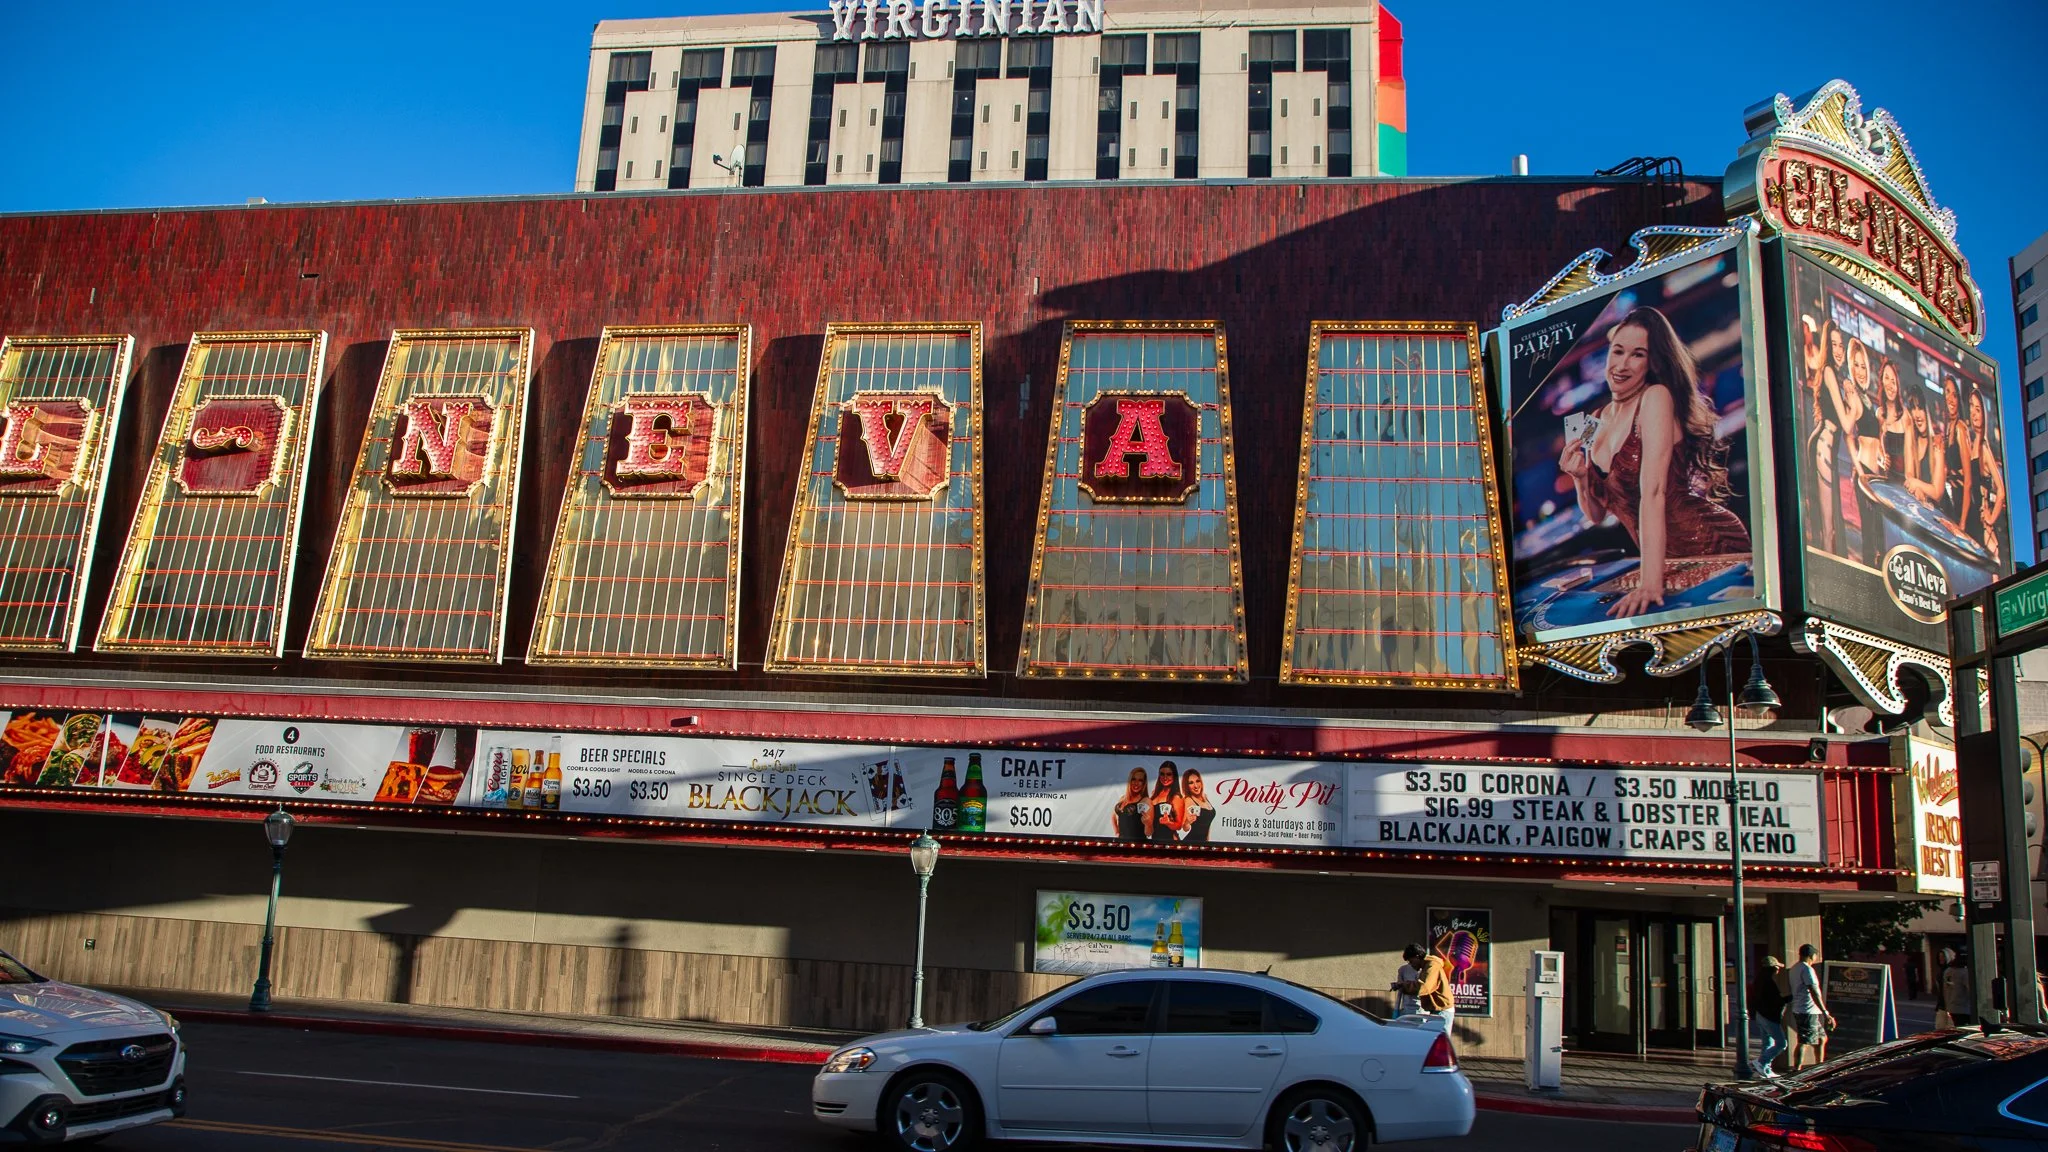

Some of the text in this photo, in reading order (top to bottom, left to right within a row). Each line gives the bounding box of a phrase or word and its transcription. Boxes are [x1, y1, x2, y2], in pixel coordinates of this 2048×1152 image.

[829, 0, 1105, 41] VIRGINIAN
[1513, 323, 1577, 360] PARTY
[1892, 554, 1915, 585] Cal
[1916, 562, 1947, 595] Neva
[1918, 595, 1931, 610] Best
[1931, 600, 1942, 613] Bet
[2011, 602, 2018, 615] N
[287, 730, 295, 741] 4
[255, 745, 326, 758] FOOD RESTAURANTS
[580, 747, 666, 766] BEER SPECIALS
[762, 748, 785, 760] 24/7
[288, 773, 317, 781] SPORTS
[500, 759, 508, 785] LIGHT
[717, 771, 827, 786] SINGLE DECK
[1000, 757, 1067, 779] CRAFT
[572, 777, 611, 798] $3.50
[629, 780, 669, 802] $3.50
[1405, 770, 1467, 793] $3.50
[1481, 773, 1570, 796] CORONA
[1614, 776, 1677, 799] $3.50
[687, 783, 858, 820] BLACKJACK
[1215, 777, 1342, 816] Party Pit
[934, 807, 958, 822] 805
[1010, 805, 1052, 828] $5.00
[1424, 796, 1494, 818] $16.99
[1512, 799, 1584, 822] STEAK
[1594, 802, 1610, 823] &
[1617, 803, 1720, 826] LOBSTER
[1221, 816, 1336, 832] Fridays & Saturdays at 8pm
[1235, 829, 1259, 837] Blackjack
[1262, 830, 1279, 838] 3-Card
[1280, 831, 1294, 839] Poker
[1630, 828, 1706, 851] CRAPS
[1714, 831, 1731, 852] &
[1740, 831, 1797, 854] KENO
[1920, 845, 1951, 877] BEST
[1067, 901, 1131, 932] $3.50
[1066, 932, 1087, 940] SERVED
[1100, 933, 1107, 941] AT
[1107, 934, 1117, 942] ALL
[1117, 934, 1132, 942] BARS
[1449, 983, 1483, 996] RAOKE
